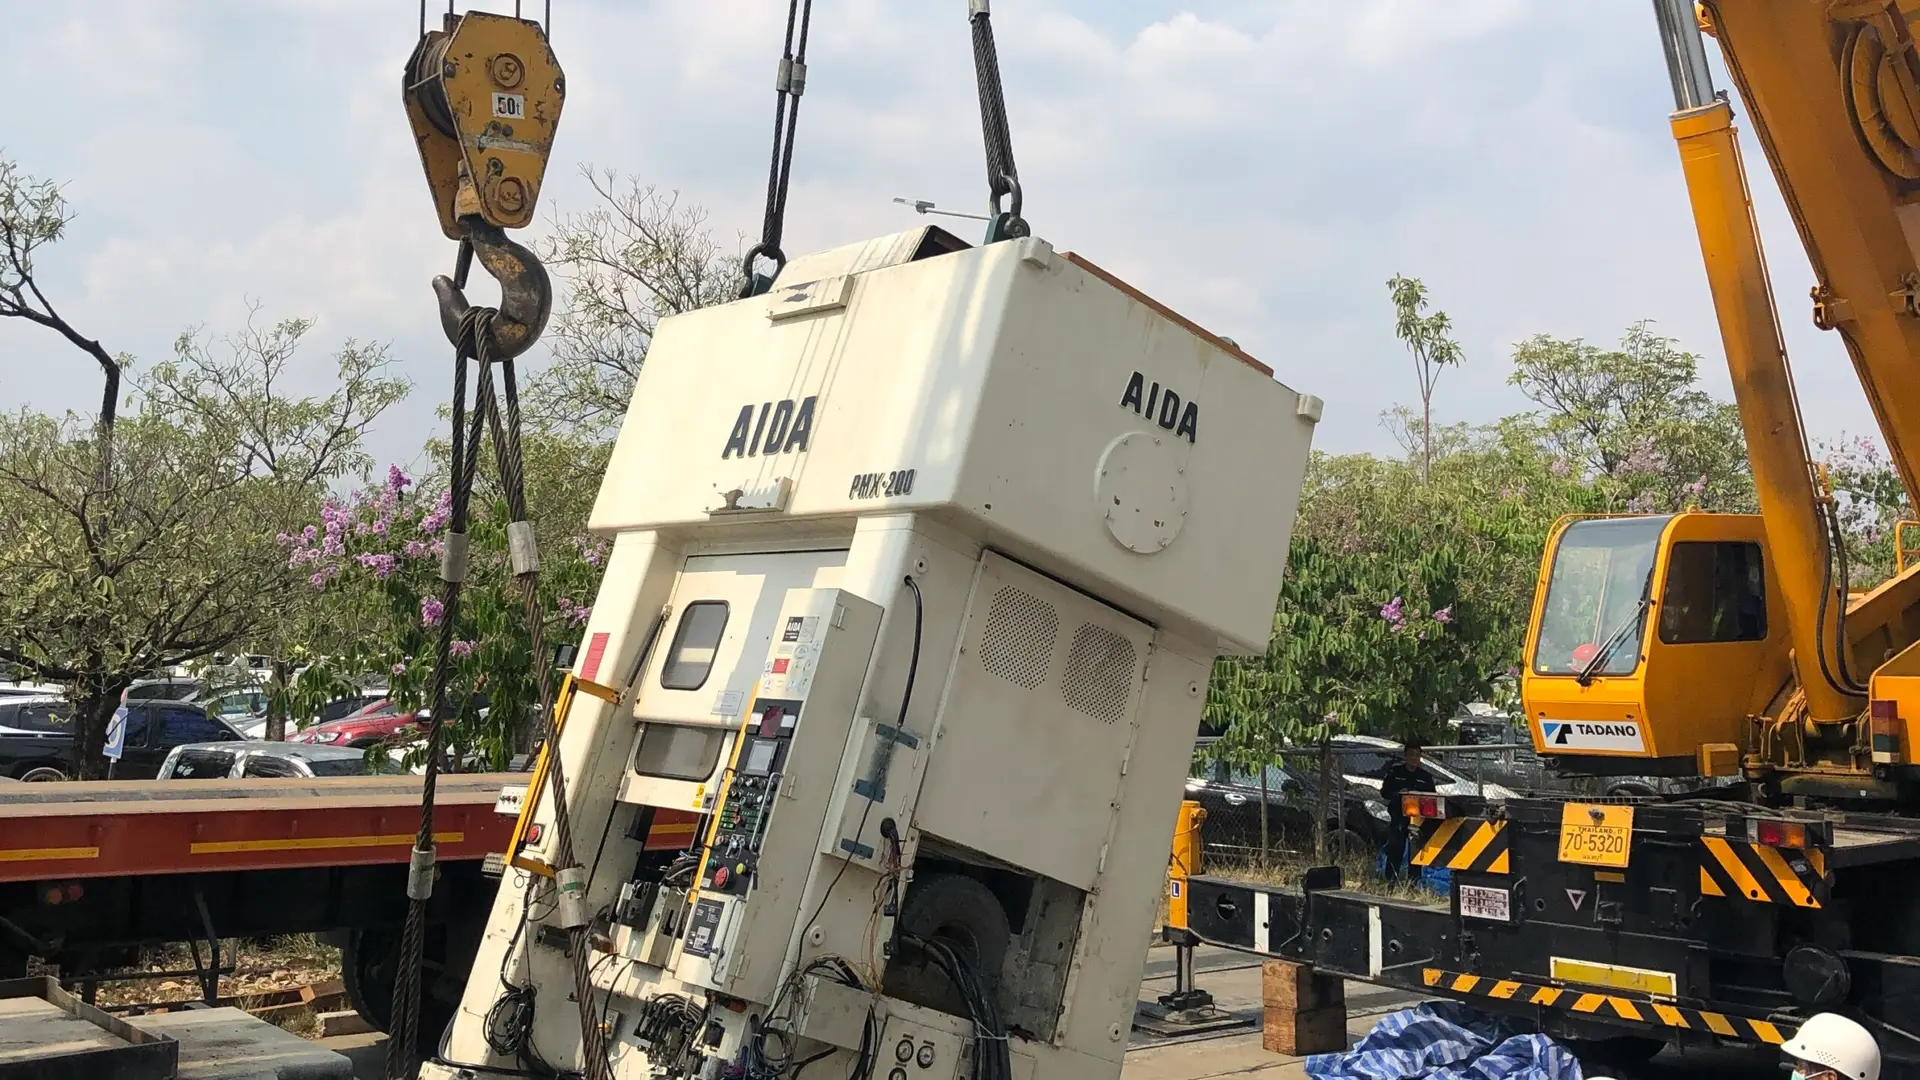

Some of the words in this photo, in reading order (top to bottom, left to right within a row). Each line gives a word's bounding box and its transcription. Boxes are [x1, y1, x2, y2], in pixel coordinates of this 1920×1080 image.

[1119, 370, 1198, 444] AIDA
[721, 395, 818, 460] AIDA
[849, 468, 917, 500] PMX-200
[1576, 724, 1637, 737] TADANO
[1564, 832, 1623, 854] 70-5320
[1173, 883, 1179, 896] L
